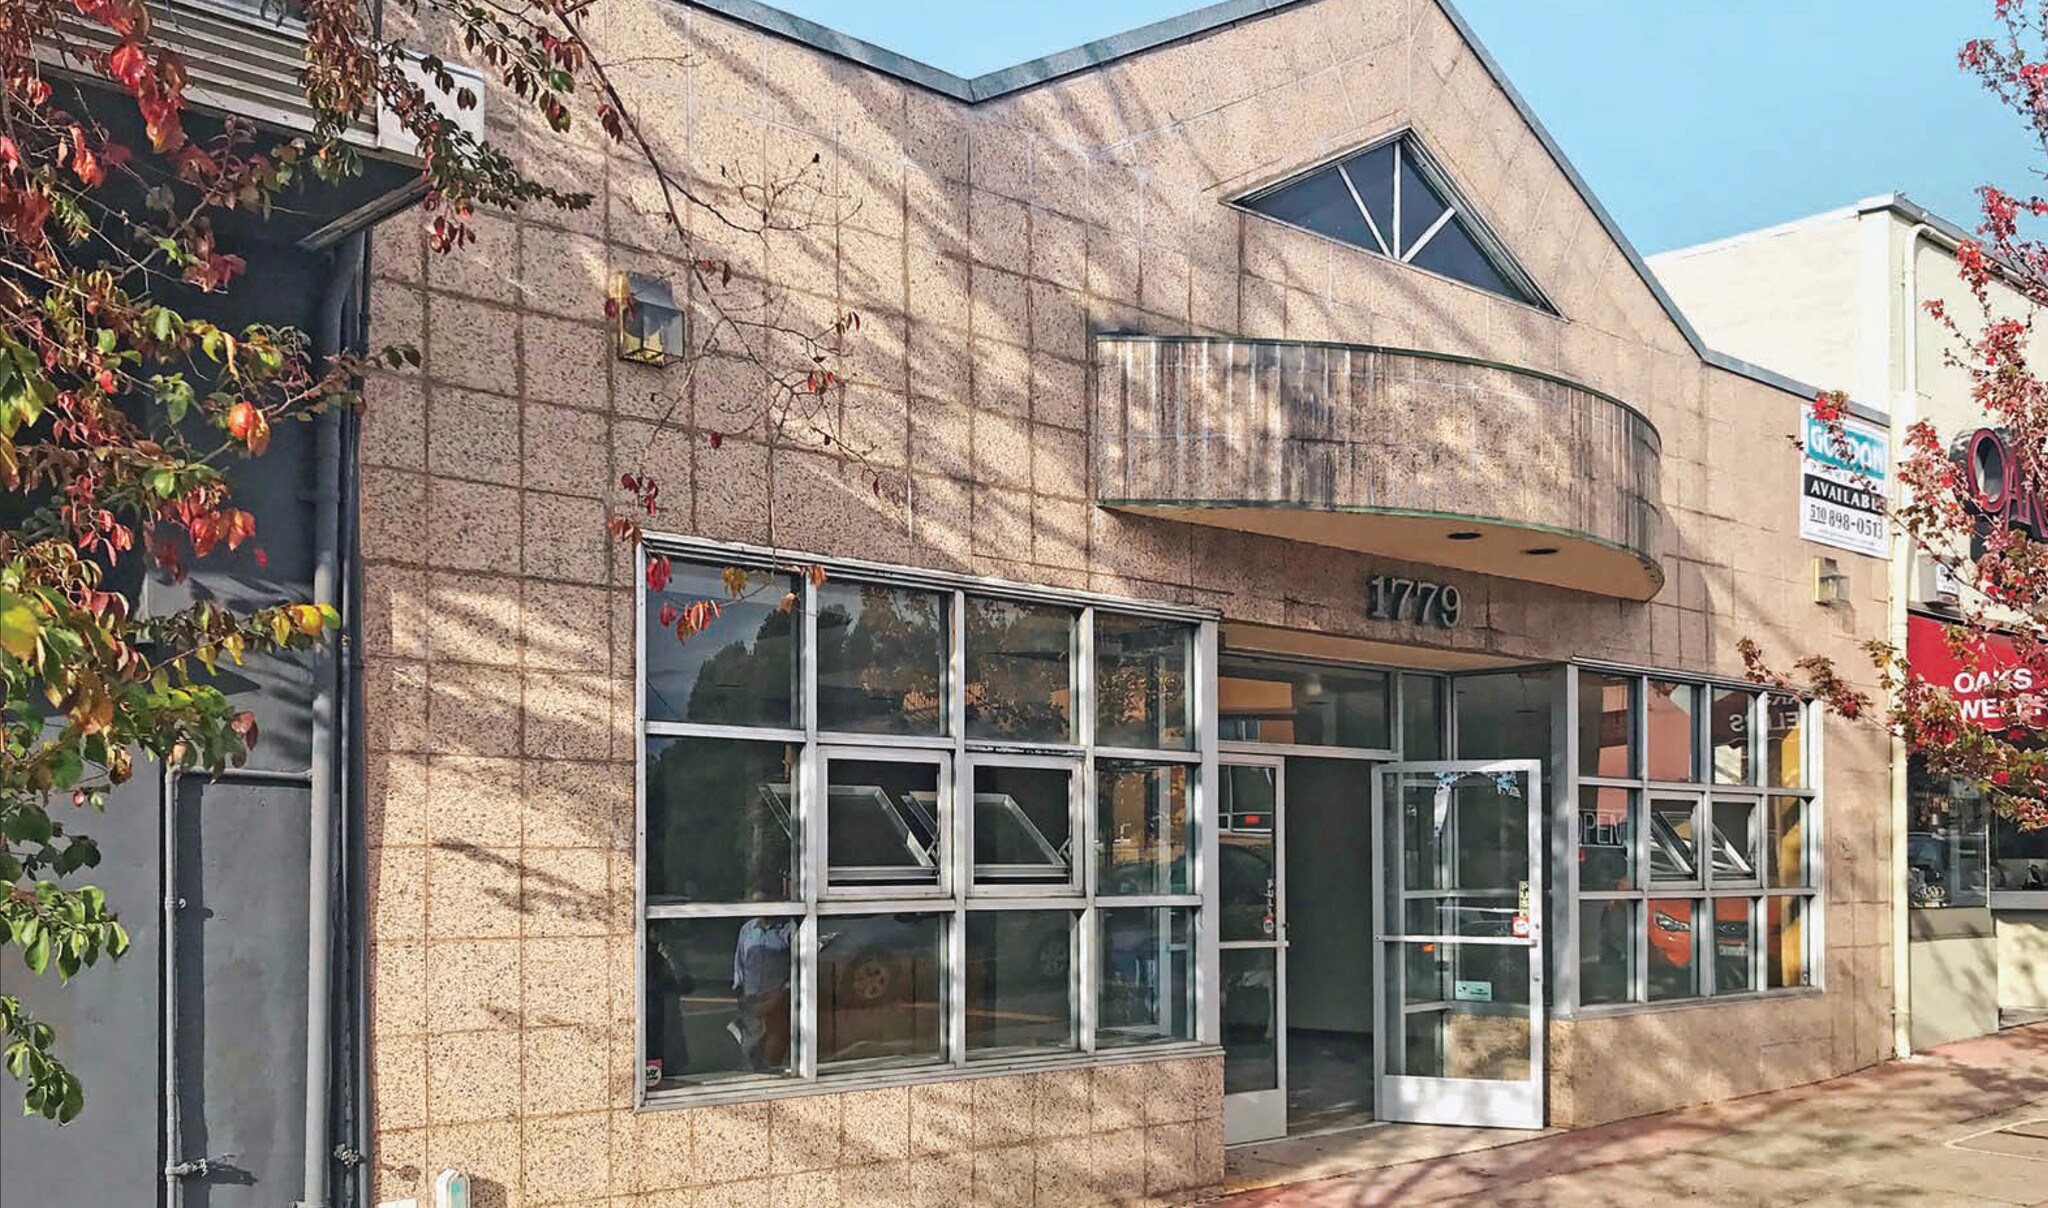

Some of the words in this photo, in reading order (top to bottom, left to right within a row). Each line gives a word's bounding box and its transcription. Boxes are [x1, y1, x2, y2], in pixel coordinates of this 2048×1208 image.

[1810, 425, 1884, 474] GODON
[1811, 480, 1884, 512] AVAILABL
[1810, 504, 1827, 521] 510
[1828, 510, 1884, 539] 898-0513
[1370, 575, 1462, 628] 1779
[1578, 812, 1622, 845] PEN
